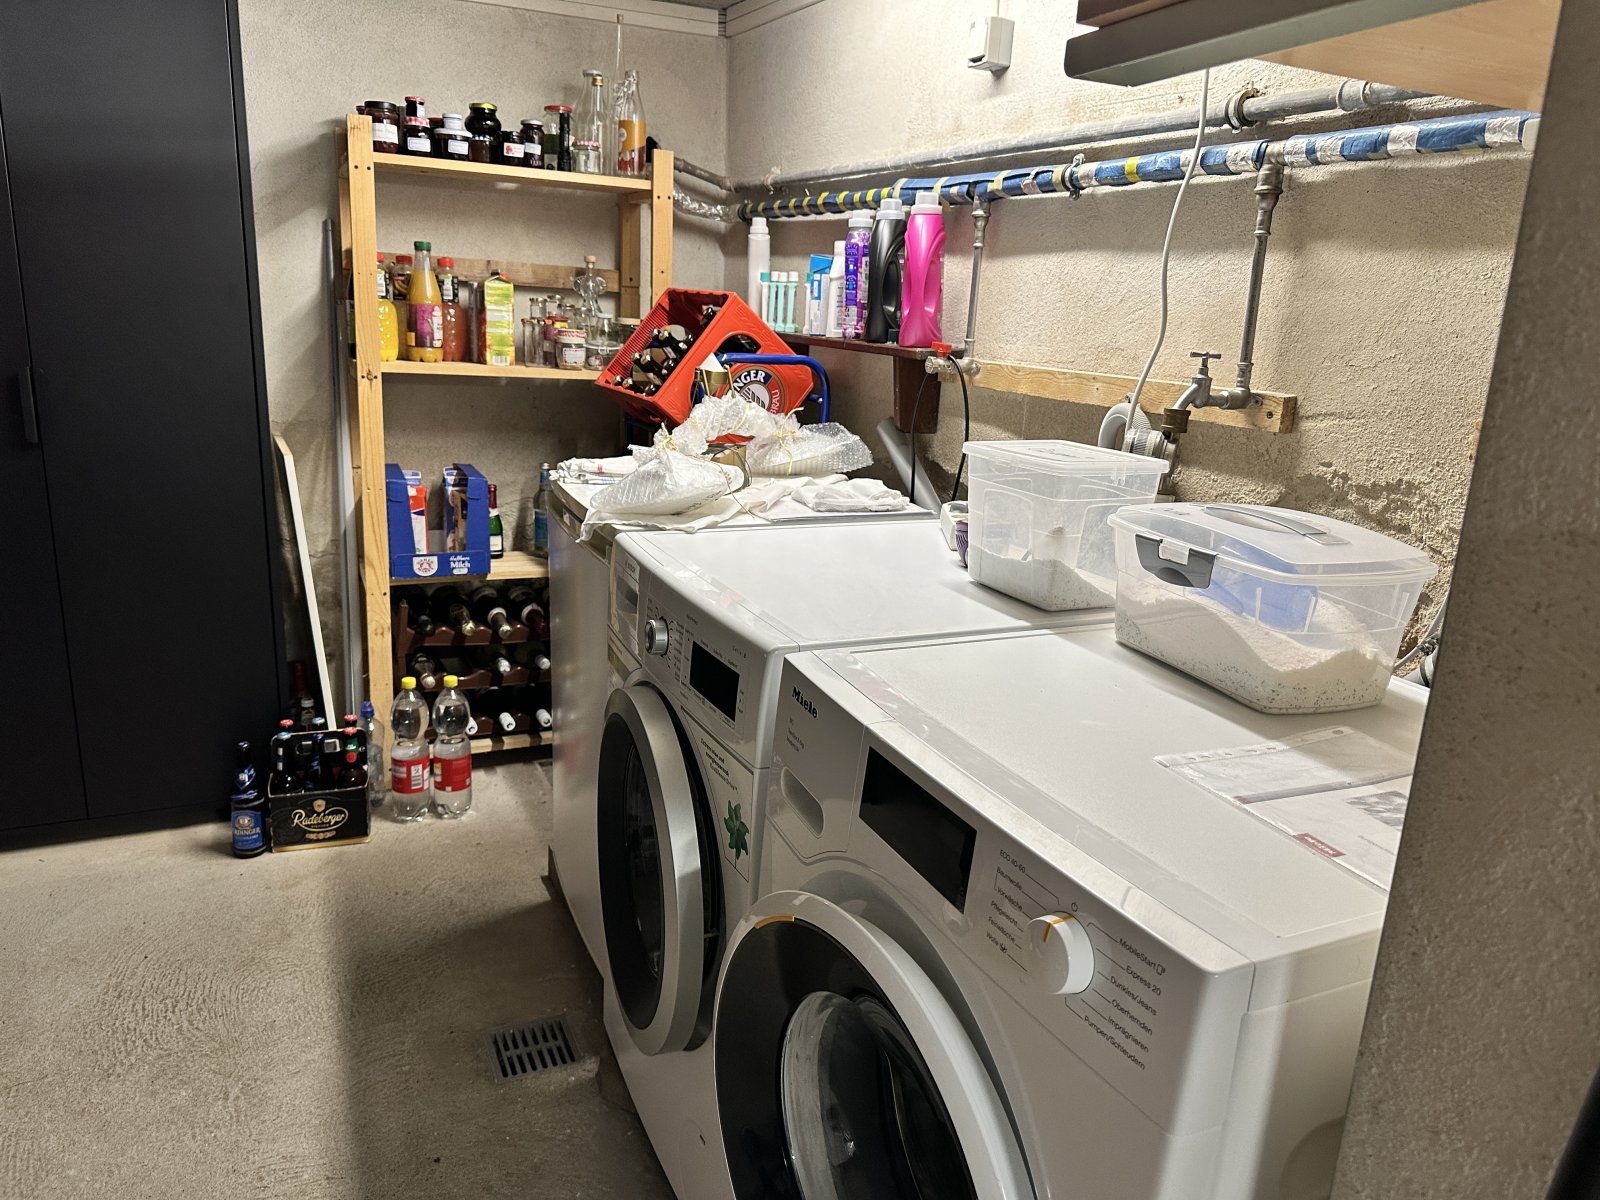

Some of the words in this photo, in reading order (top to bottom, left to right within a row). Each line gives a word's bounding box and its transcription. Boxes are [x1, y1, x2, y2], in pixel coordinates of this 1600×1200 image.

[733, 370, 766, 392] NGER
[791, 685, 818, 719] Miele
[291, 809, 346, 827] Radeberger
[1119, 937, 1157, 969] MobileStart
[1110, 975, 1157, 1017] Dunkles/Jeans
[1126, 965, 1152, 992] Express
[1151, 983, 1162, 996] 20
[1107, 1015, 1149, 1053] Imprägnieren
[1111, 999, 1153, 1036] Oberhemden
[1083, 1015, 1146, 1071] Pumpen/Schleudern
